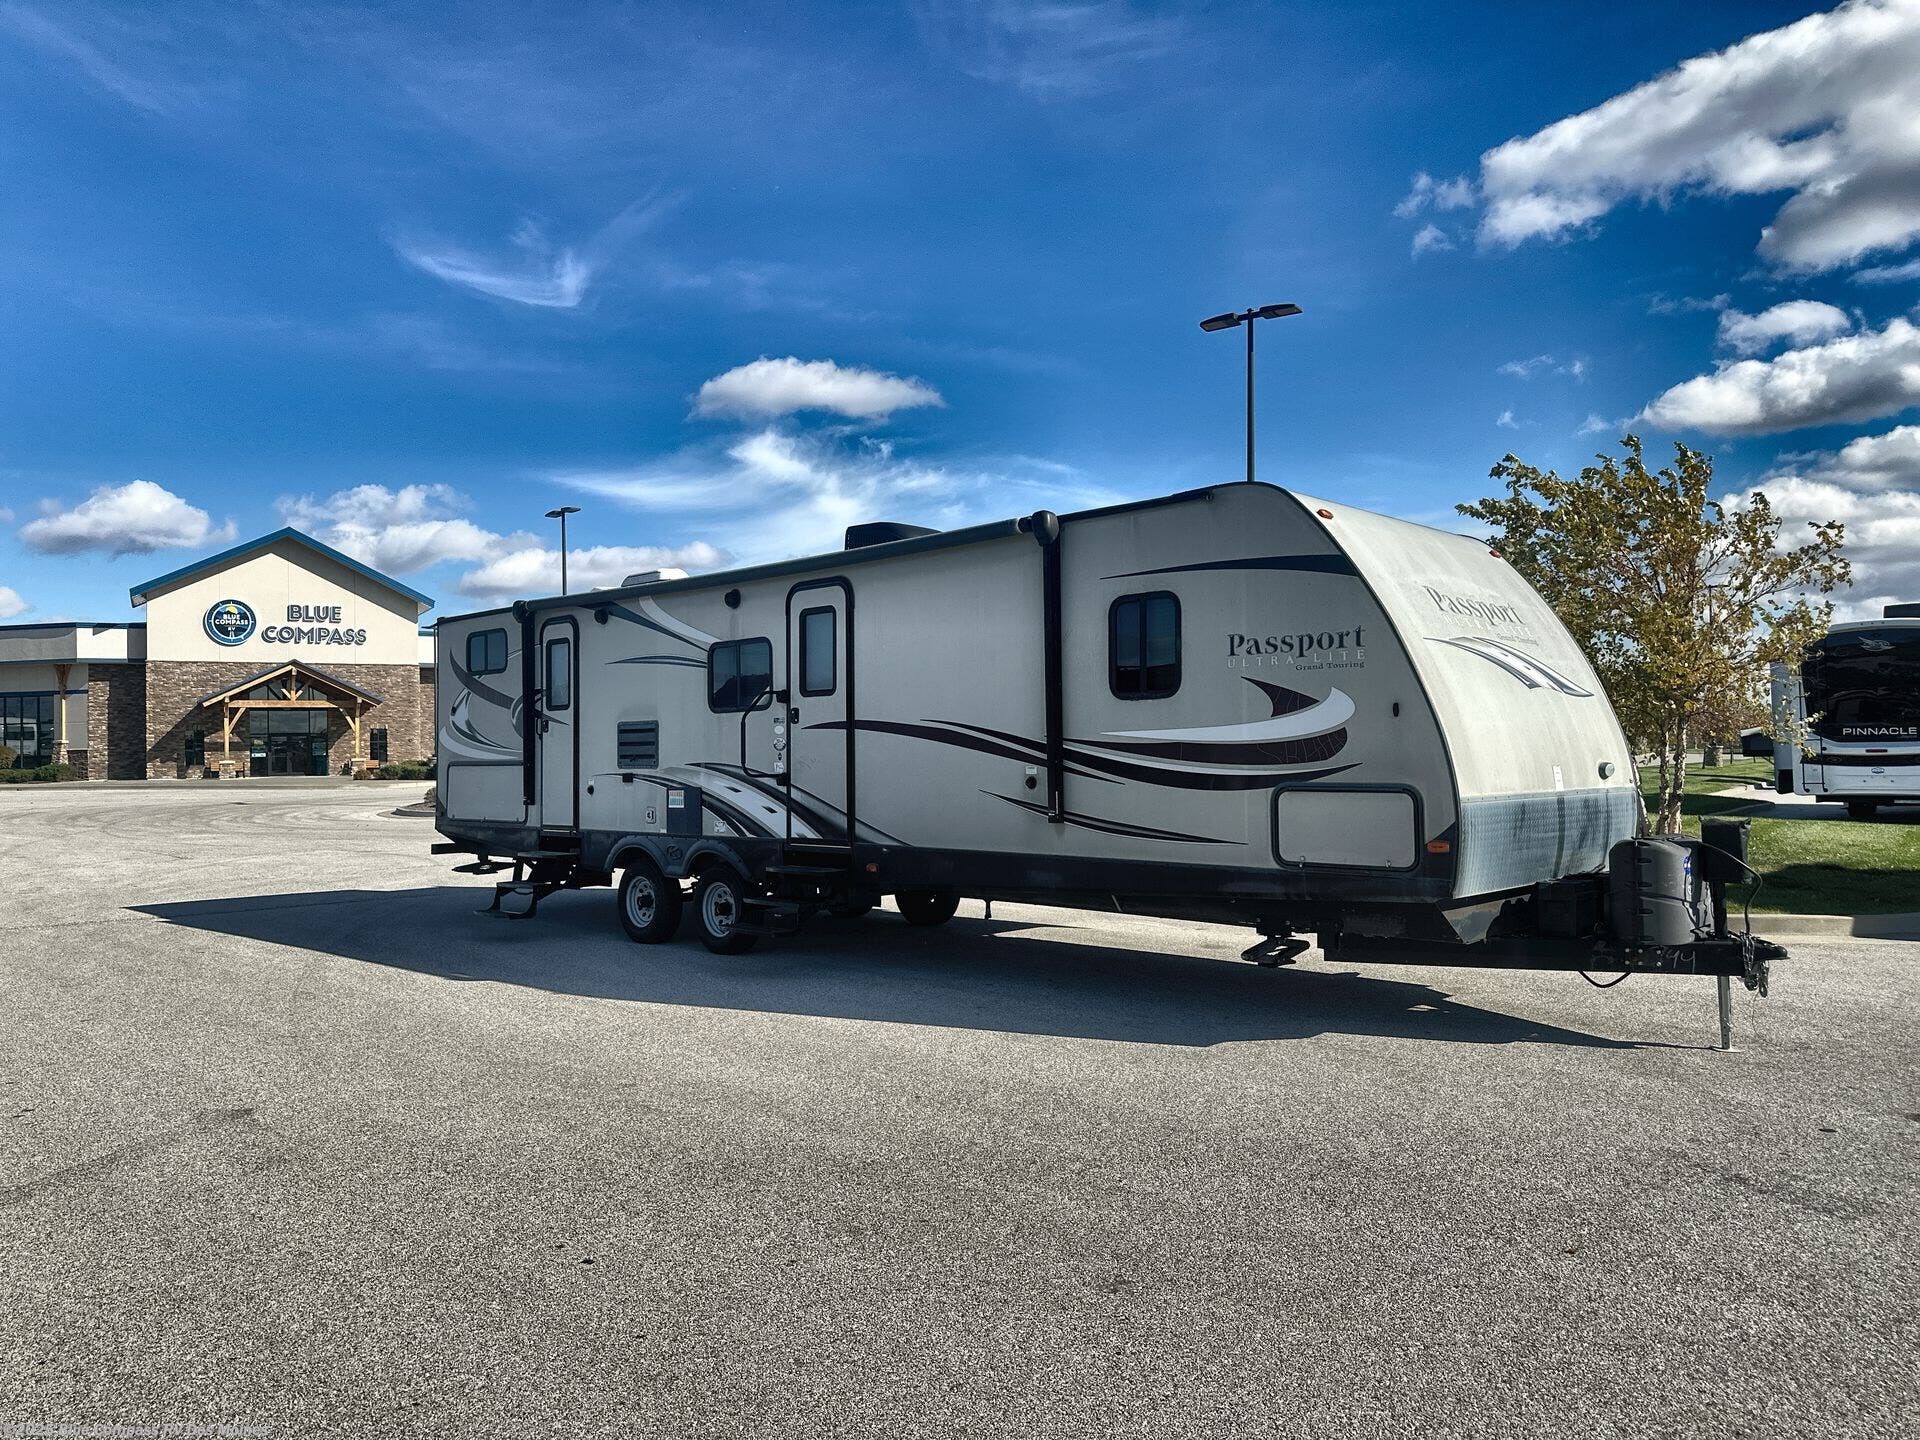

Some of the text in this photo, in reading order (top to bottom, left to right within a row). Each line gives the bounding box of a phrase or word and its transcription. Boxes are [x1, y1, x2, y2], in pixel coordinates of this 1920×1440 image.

[287, 604, 342, 623] BLUE
[1422, 585, 1526, 626] Passport
[261, 626, 367, 646] COMPASS
[1226, 624, 1366, 658] Passport
[1227, 649, 1366, 668] ULTRA LITE
[1295, 660, 1365, 671] Grand Touring
[1842, 727, 1918, 735] PINNACLE
